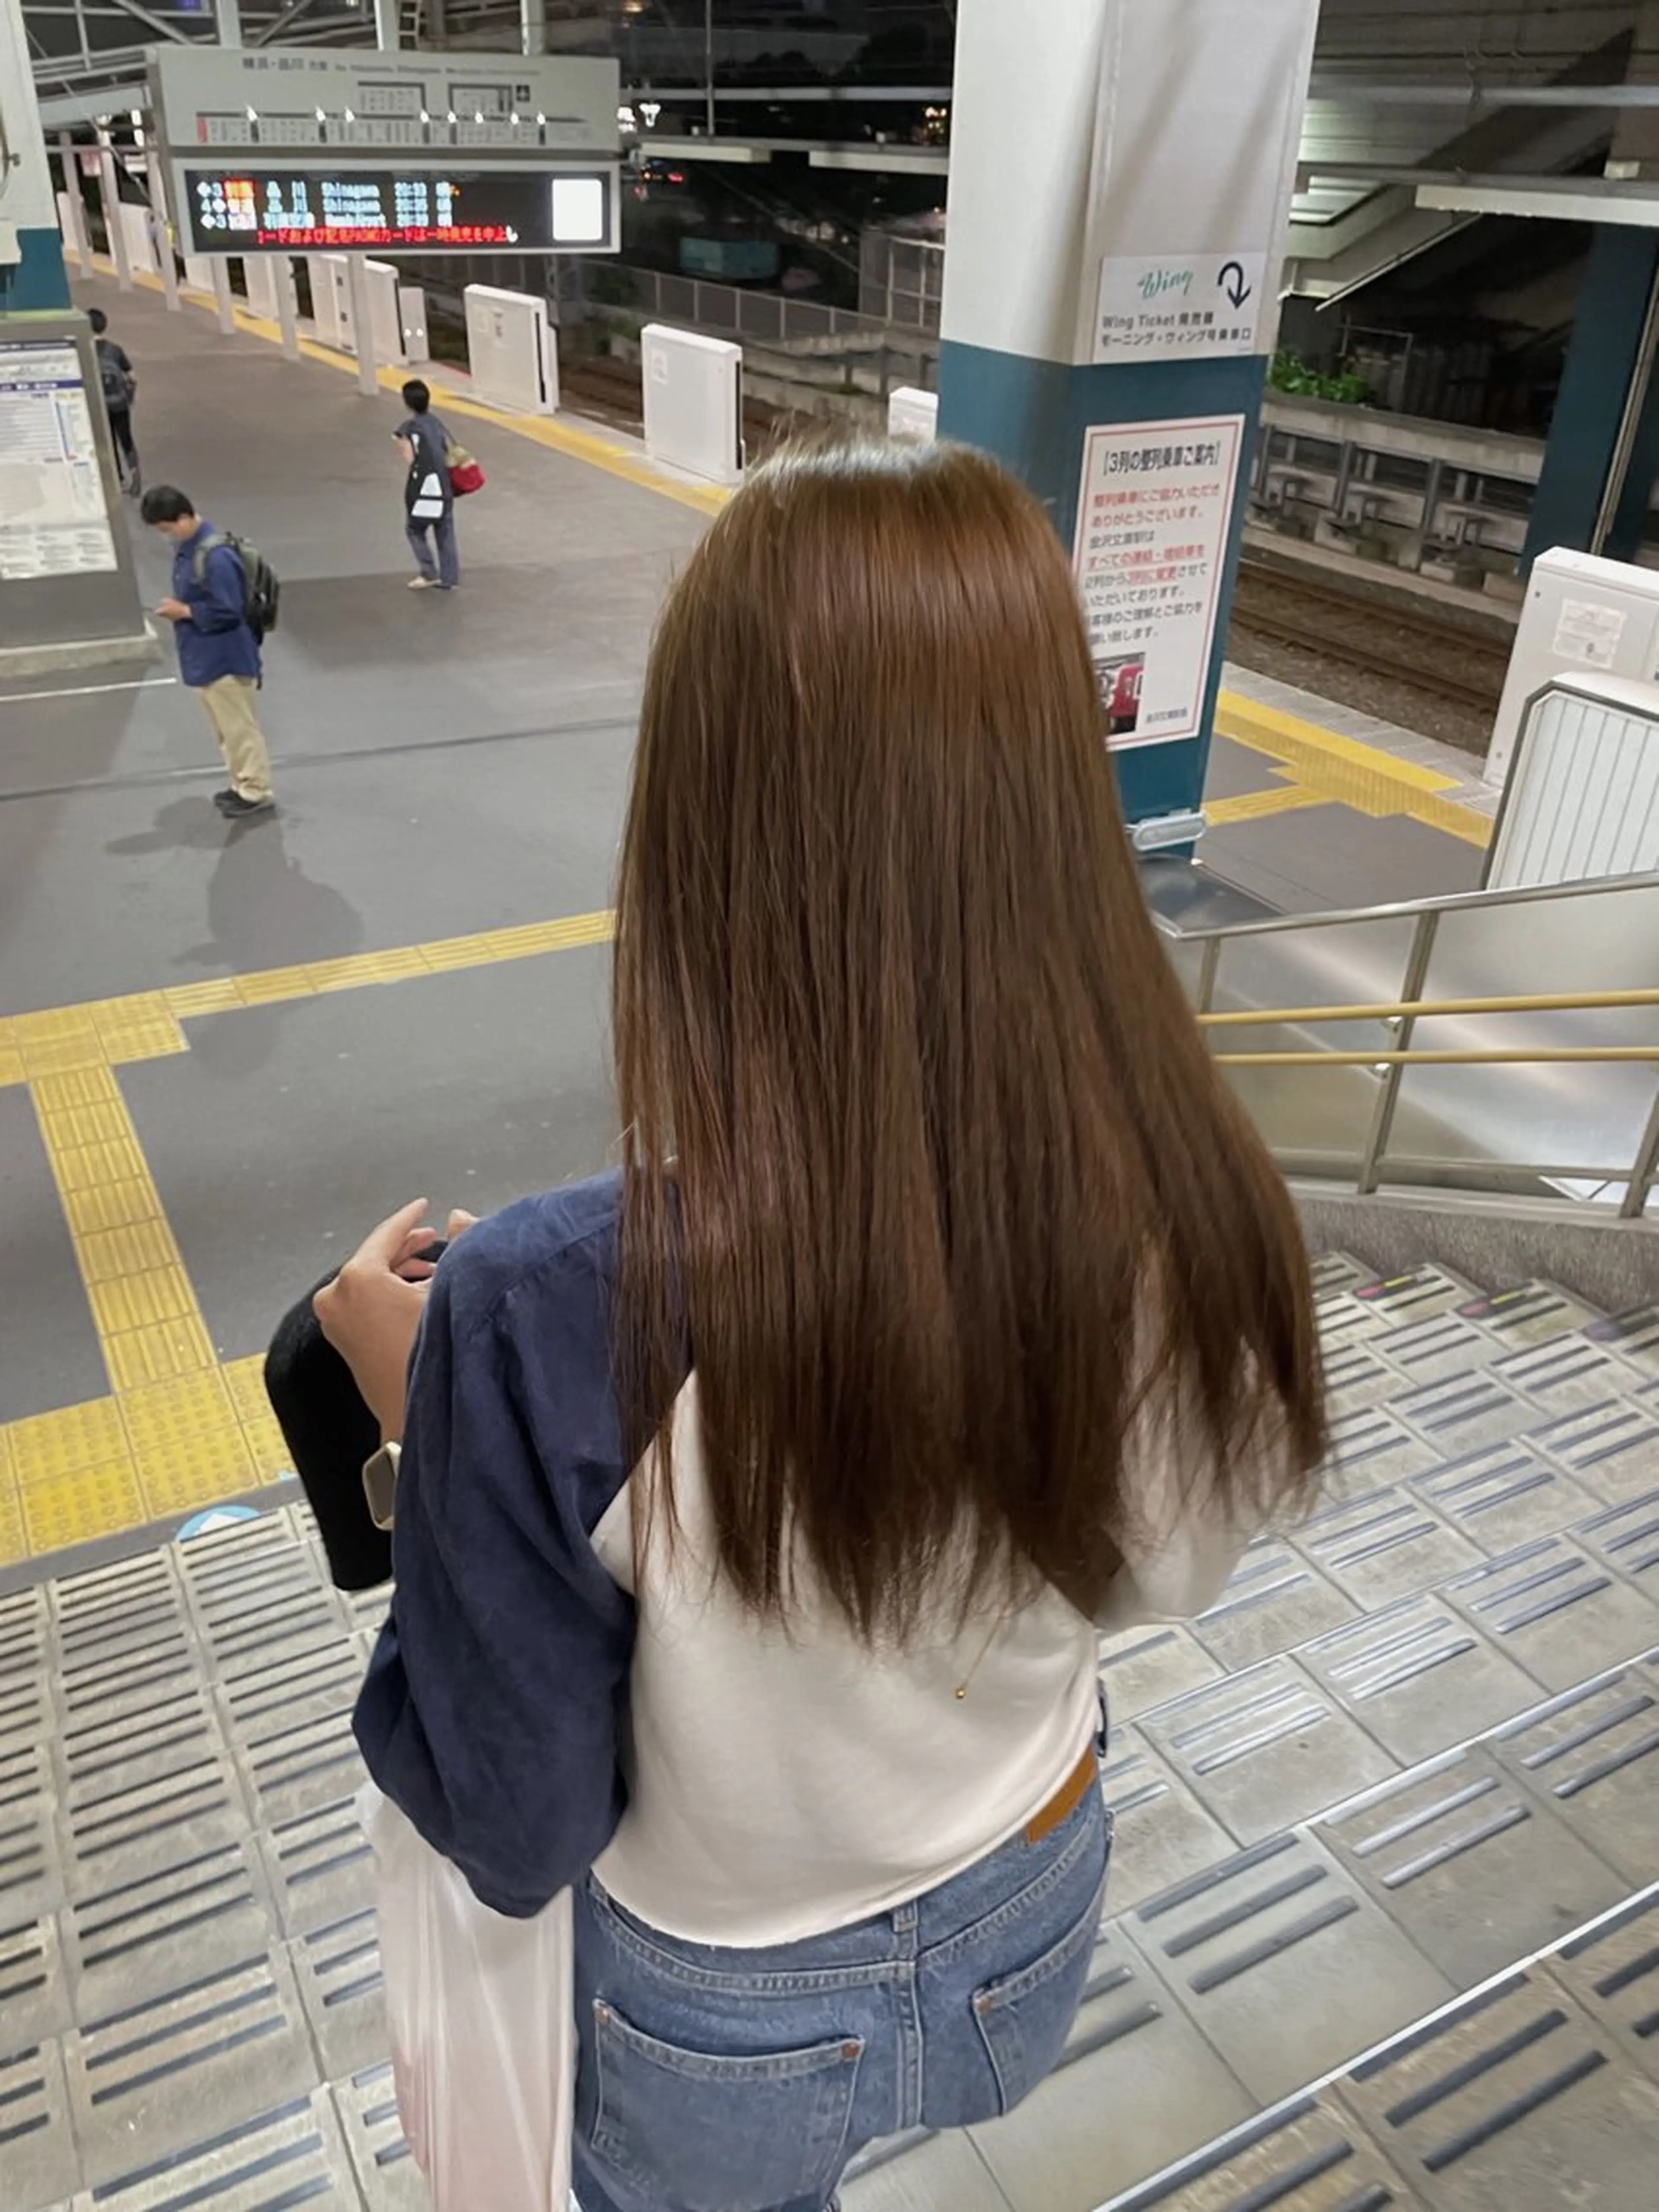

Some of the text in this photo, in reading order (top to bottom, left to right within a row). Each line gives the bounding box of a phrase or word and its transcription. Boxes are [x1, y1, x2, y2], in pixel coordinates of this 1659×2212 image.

[1137, 270, 1194, 299] Wing
[1103, 315, 1134, 330] Wing
[1139, 314, 1175, 327] Ticket
[1090, 601, 1203, 626] 客様のご理解とご協力を
